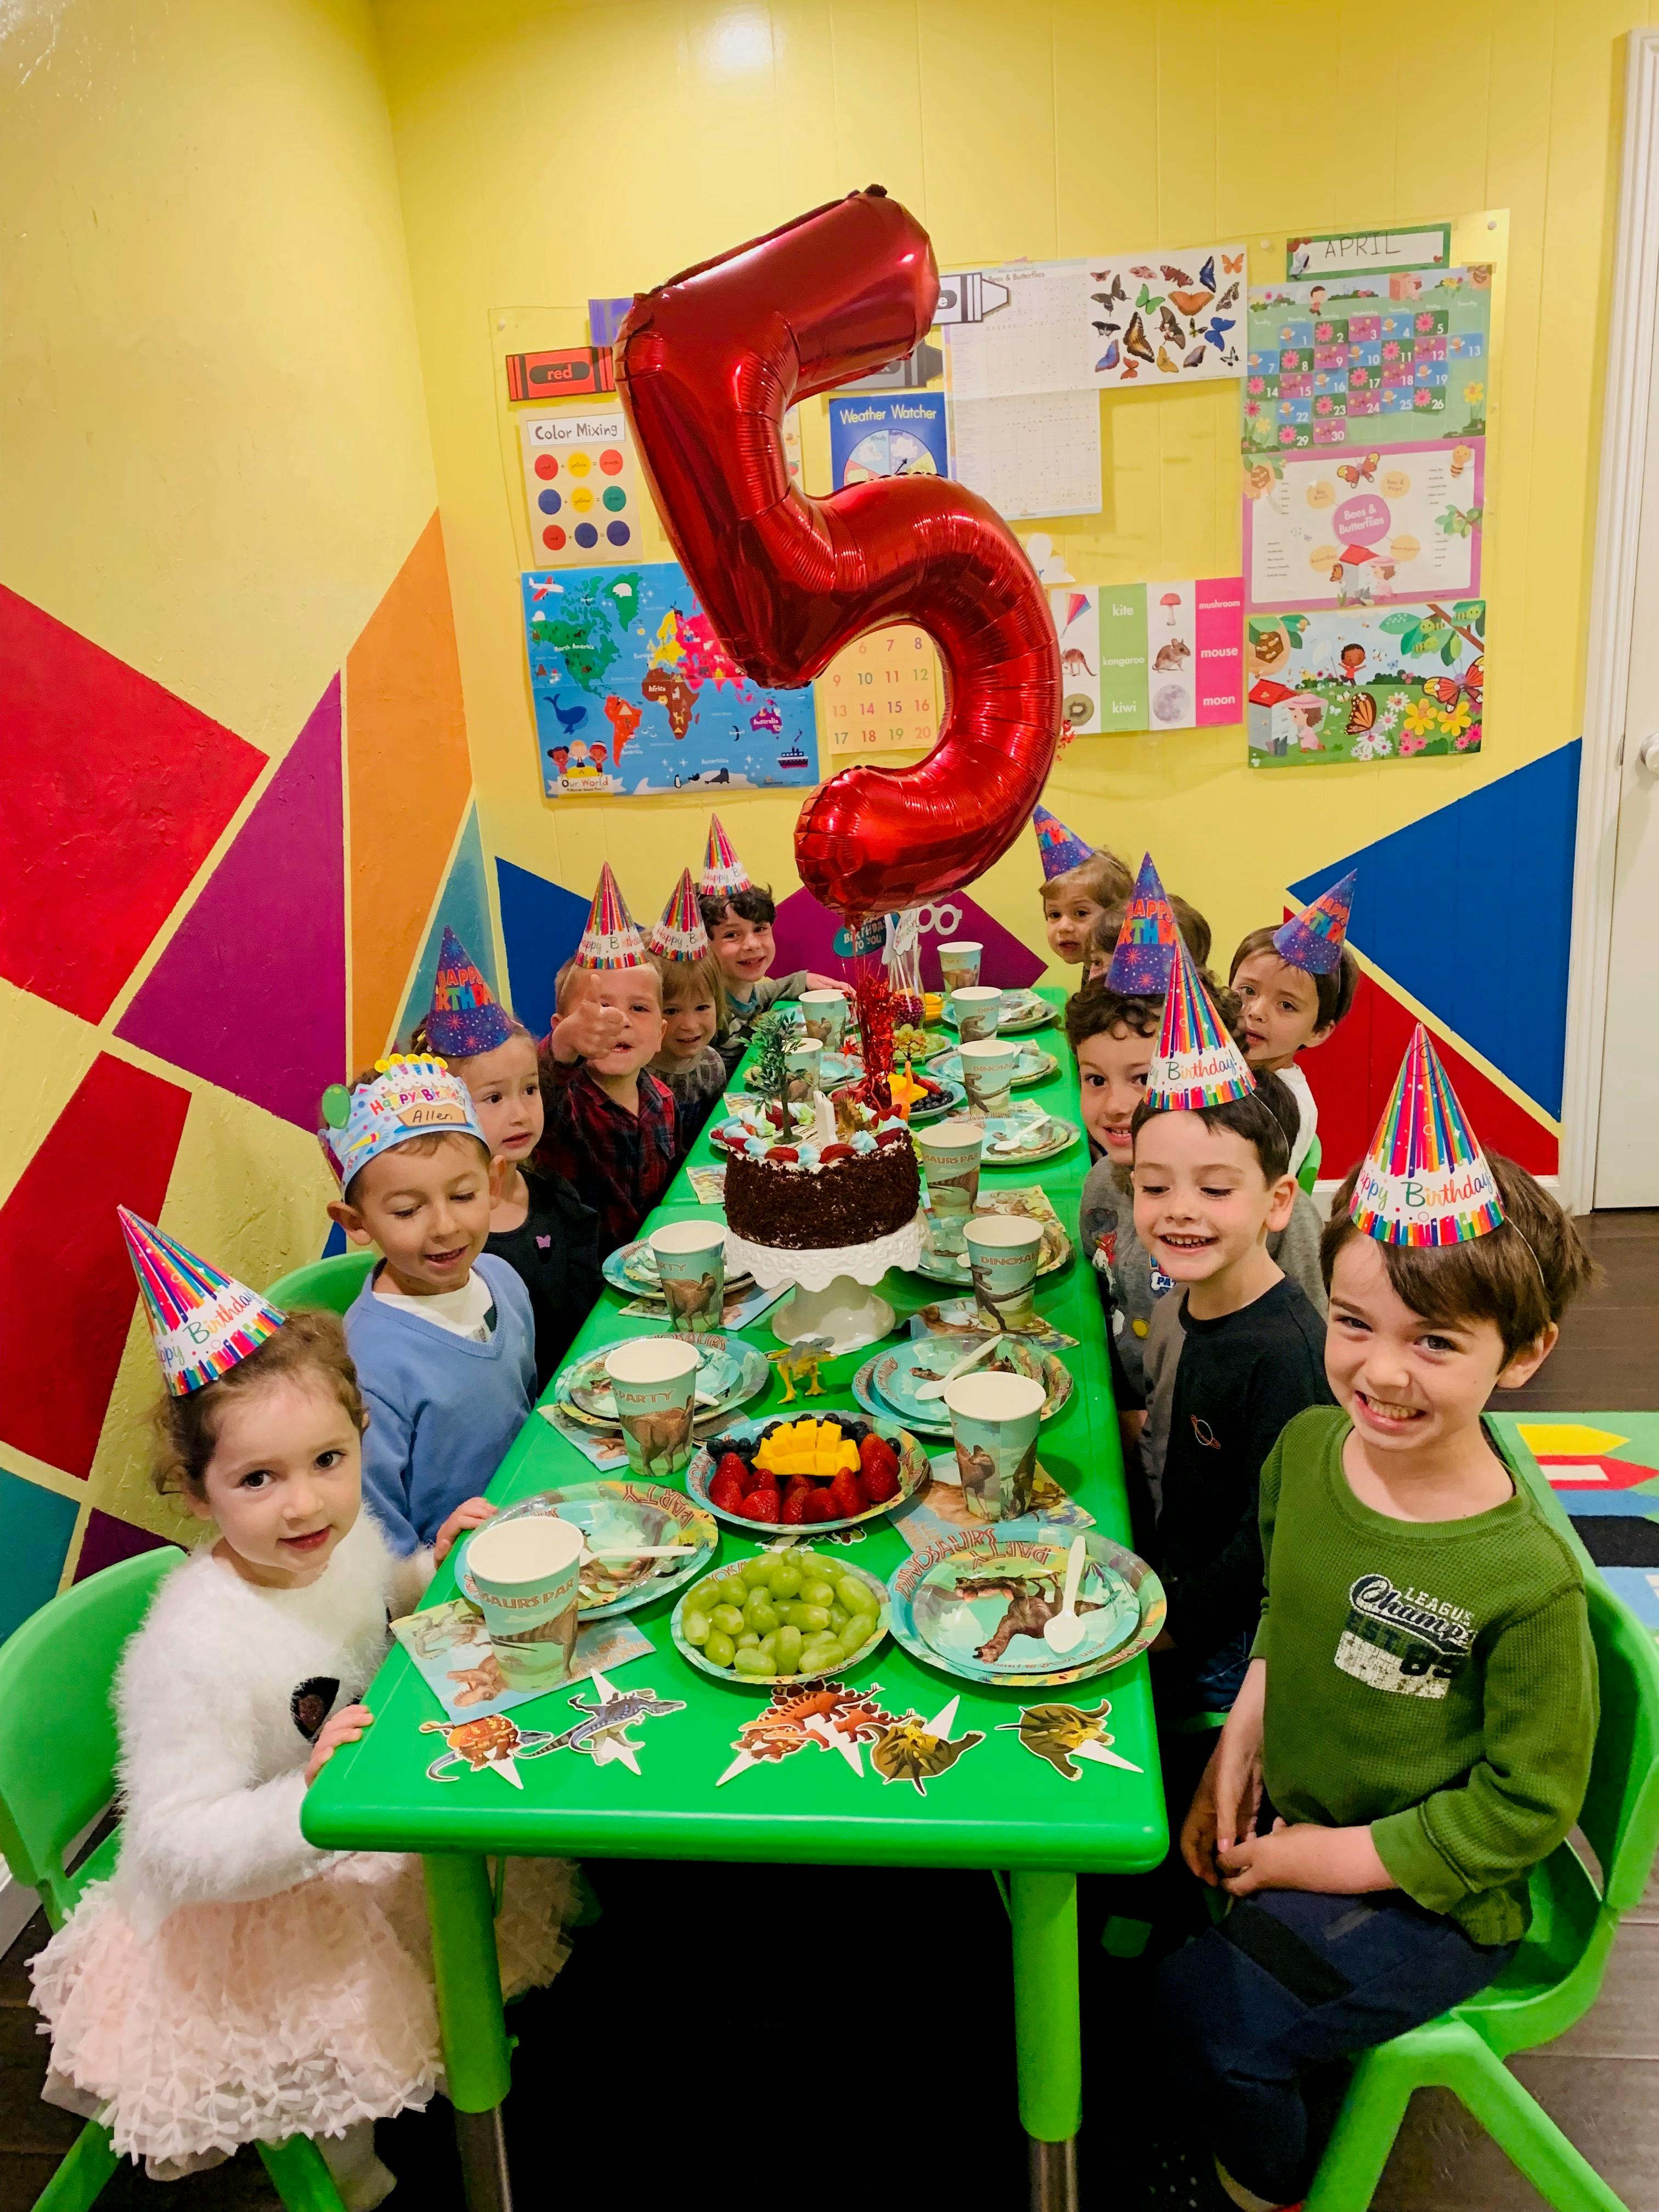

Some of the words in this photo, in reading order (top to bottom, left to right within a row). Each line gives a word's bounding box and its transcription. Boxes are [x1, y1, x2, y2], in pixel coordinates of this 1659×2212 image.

[1325, 231, 1401, 258] APRIL
[1013, 270, 1045, 280] Butterflies
[1302, 336, 1307, 346] 1
[1336, 333, 1344, 343] 2
[1371, 329, 1377, 340] 3
[1403, 328, 1410, 337] 4
[1437, 323, 1444, 334] 5
[1268, 363, 1276, 374] 7
[1302, 361, 1308, 371] 8
[1336, 357, 1344, 366] 9
[1367, 354, 1380, 364] 10
[1401, 352, 1412, 362] 11
[1431, 350, 1444, 361] 12
[1469, 346, 1481, 357] 13
[548, 363, 573, 380] red
[1267, 387, 1279, 398] 14
[1299, 386, 1311, 397] 15
[1334, 382, 1346, 392] 16
[1369, 378, 1381, 388] 17
[1401, 375, 1414, 385] 18
[1436, 374, 1448, 385] 19
[840, 405, 886, 425] Weather
[891, 404, 936, 420] Watcher
[1296, 412, 1308, 422] 22
[1333, 405, 1346, 416] 23
[1366, 402, 1380, 413] 24
[1400, 399, 1412, 410] 25
[1431, 399, 1444, 410] 26
[535, 422, 572, 441] Color
[577, 422, 618, 438] Mixing
[1296, 436, 1309, 446] 29
[1331, 431, 1344, 442] 30
[1344, 508, 1366, 520] Bees
[1369, 503, 1376, 514] &
[1339, 516, 1384, 534] Butterflies
[1112, 603, 1134, 617] kite
[1199, 599, 1240, 610] mushroom
[859, 641, 867, 654] 6
[887, 639, 895, 652] 7
[915, 637, 922, 650] 8
[1200, 647, 1238, 658] mouse
[1103, 656, 1145, 667] kangaroo
[833, 674, 841, 687] 9
[857, 672, 873, 685] 10
[885, 670, 899, 683] 11
[913, 668, 928, 681] 12
[832, 704, 848, 717] 13
[860, 702, 874, 715] 14
[888, 701, 902, 714] 15
[915, 699, 929, 712] 16
[1112, 701, 1137, 714] kiwi
[1203, 695, 1235, 706] moon
[753, 716, 779, 725] Australia
[834, 732, 849, 744] 17
[861, 730, 876, 742] 18
[889, 728, 904, 741] 19
[915, 726, 931, 739] 20
[562, 780, 578, 788] Our
[582, 776, 608, 786] World
[413, 1110, 453, 1123] Allen
[622, 1484, 697, 1530] PARTY
[895, 1528, 997, 1602] DINOSAURS
[969, 1541, 1052, 1571] PARTY
[1403, 1587, 1475, 1627] LEAGUE
